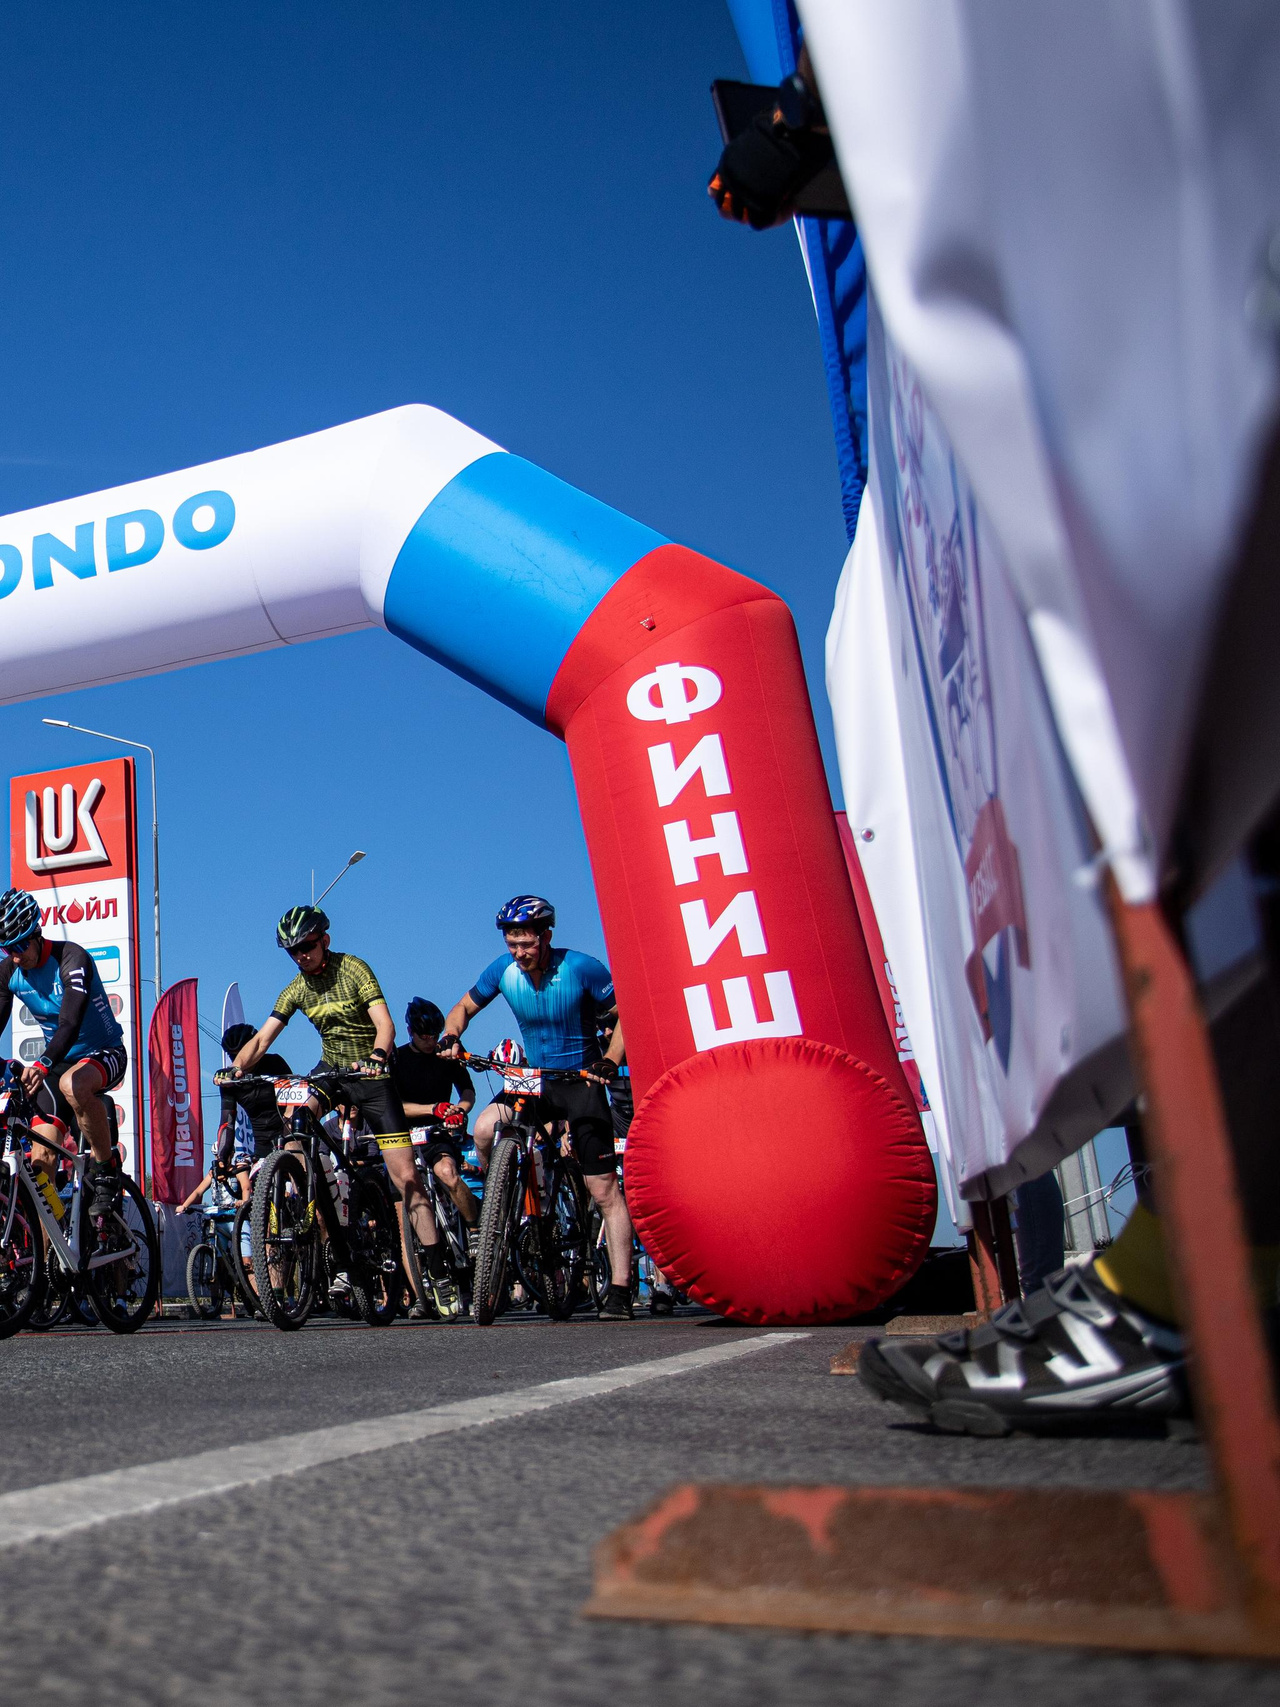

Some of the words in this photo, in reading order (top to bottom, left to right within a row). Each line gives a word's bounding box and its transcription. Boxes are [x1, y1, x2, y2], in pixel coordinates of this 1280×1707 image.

[626, 662, 803, 1052] ФИНИШ
[40, 896, 118, 927] УКОЙЛ
[278, 1090, 303, 1101] 2003
